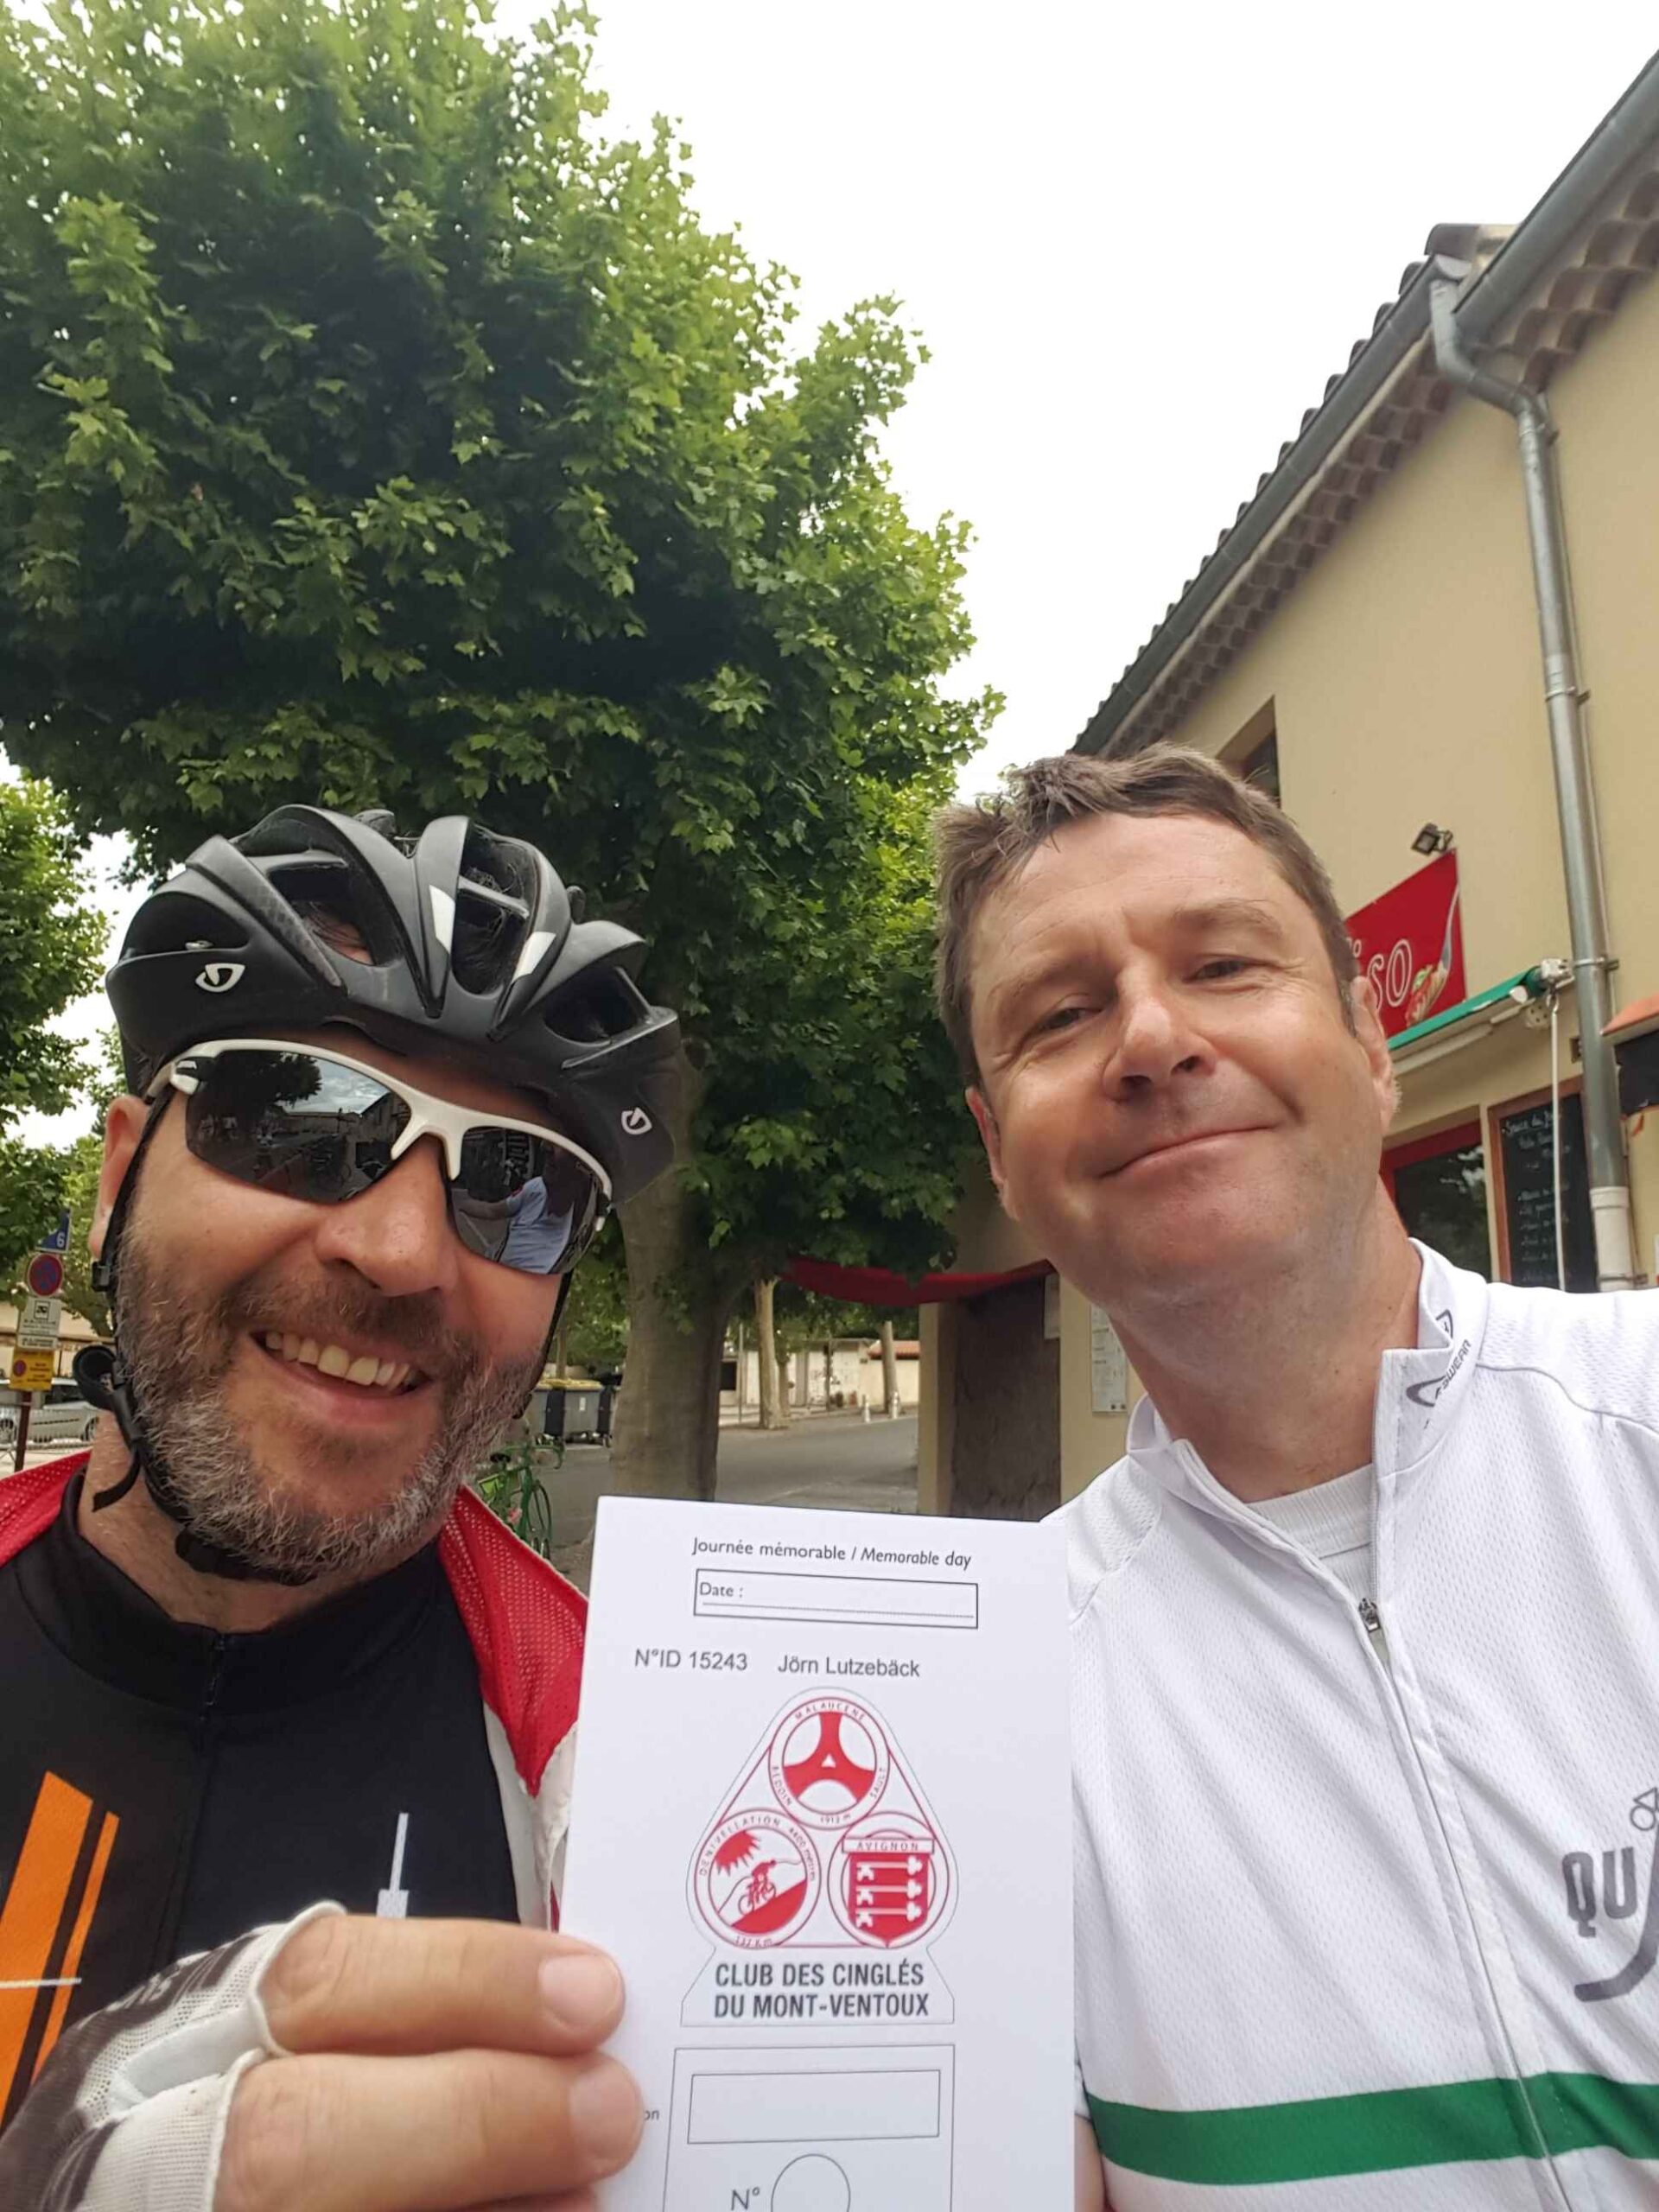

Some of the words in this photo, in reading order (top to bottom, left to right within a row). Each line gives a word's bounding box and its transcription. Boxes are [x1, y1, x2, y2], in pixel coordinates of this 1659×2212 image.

[691, 1537, 753, 1555] Journée
[760, 1541, 846, 1560] mémorable
[851, 1547, 857, 1560] /
[860, 1547, 939, 1565] Memorable
[945, 1550, 972, 1570] day
[699, 1582, 734, 1598] Date
[634, 1649, 681, 1668] N°ID
[689, 1651, 747, 1671] 15243
[778, 1655, 818, 1674] Jörn
[826, 1656, 919, 1677] Lutzebäck
[856, 1841, 918, 1852] AVIGNON
[715, 1962, 773, 1987] CLUB
[782, 1962, 825, 1987] DES
[833, 1958, 925, 1986] CINGLÉS
[714, 1994, 746, 2018] DU
[753, 1993, 931, 2018] MONT-VENTOUX
[730, 2186, 760, 2211] N°
